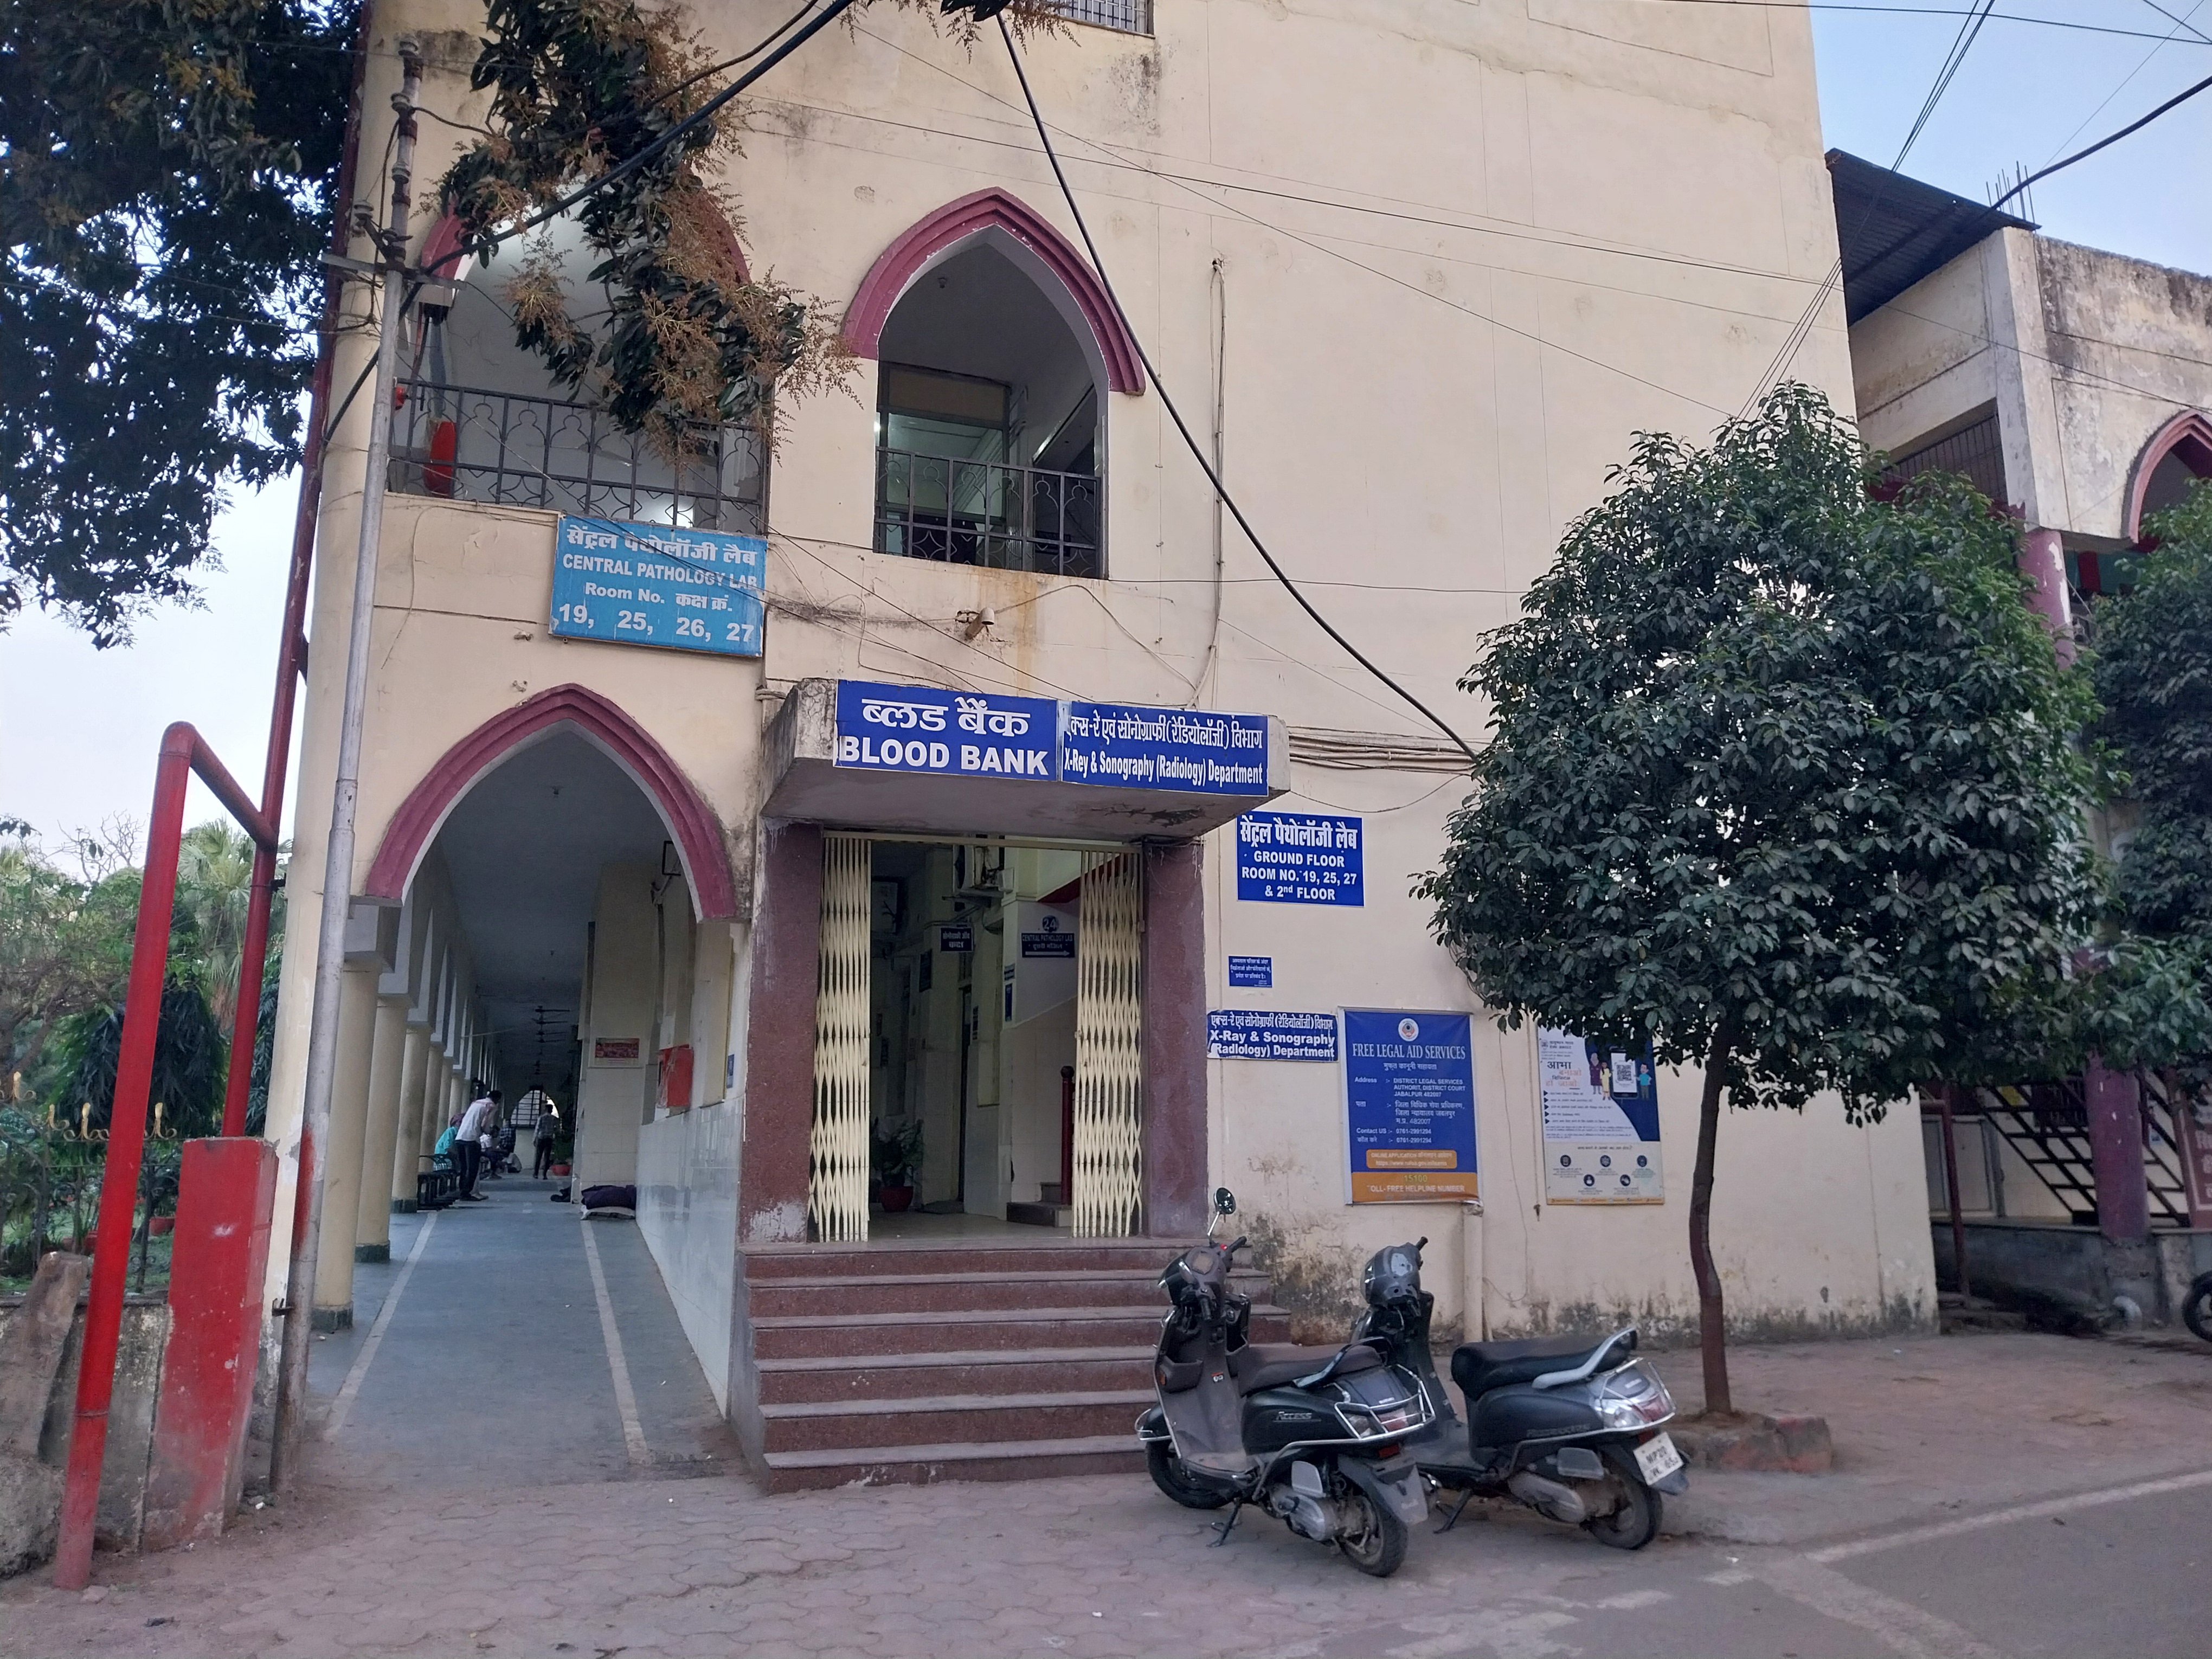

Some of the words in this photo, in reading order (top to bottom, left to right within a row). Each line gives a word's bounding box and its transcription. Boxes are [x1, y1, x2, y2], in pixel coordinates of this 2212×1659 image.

[723, 544, 757, 566] लैब
[563, 554, 632, 576] CENTRAL
[637, 562, 725, 587] PATHOLOGY
[729, 573, 757, 590] LAB
[586, 582, 632, 600] Room
[638, 588, 665, 603] No.
[676, 593, 708, 609] कक्ष
[559, 603, 594, 629] 19,
[617, 610, 653, 635] 25,
[676, 617, 711, 642] 26,
[726, 623, 754, 642] 27
[839, 735, 950, 768] BLOOD
[961, 744, 1049, 776] BANK
[1064, 747, 1088, 779] X-Rey
[1090, 750, 1098, 773] &
[1099, 751, 1154, 782] Sonography
[1156, 755, 1207, 787] (Radiology)
[1208, 759, 1263, 787] Department
[1335, 821, 1358, 849] लैब
[1254, 850, 1303, 865] GROUND
[1307, 853, 1345, 867] FLOOR
[1242, 867, 1276, 880] ROOM
[1279, 869, 1300, 882] NO.
[1303, 871, 1320, 885] 19,
[1323, 872, 1341, 886] 25,
[1343, 873, 1357, 885] 27
[1265, 885, 1274, 897] &
[1277, 885, 1293, 897] 2nd
[1297, 887, 1335, 900] FLOOR
[1044, 918, 1056, 930] 24
[1210, 1030, 1246, 1044] X-Ray
[1250, 1031, 1259, 1041] &
[1263, 1031, 1335, 1047] Sonography
[1274, 1044, 1335, 1058] Department
[1353, 1043, 1374, 1057] FREE
[1377, 1044, 1405, 1058] LEGAL
[1406, 1045, 1423, 1058] AID
[1425, 1046, 1465, 1059] SERVICES
[1547, 1061, 1571, 1069] आभा
[1404, 1174, 1427, 1182] 15100
